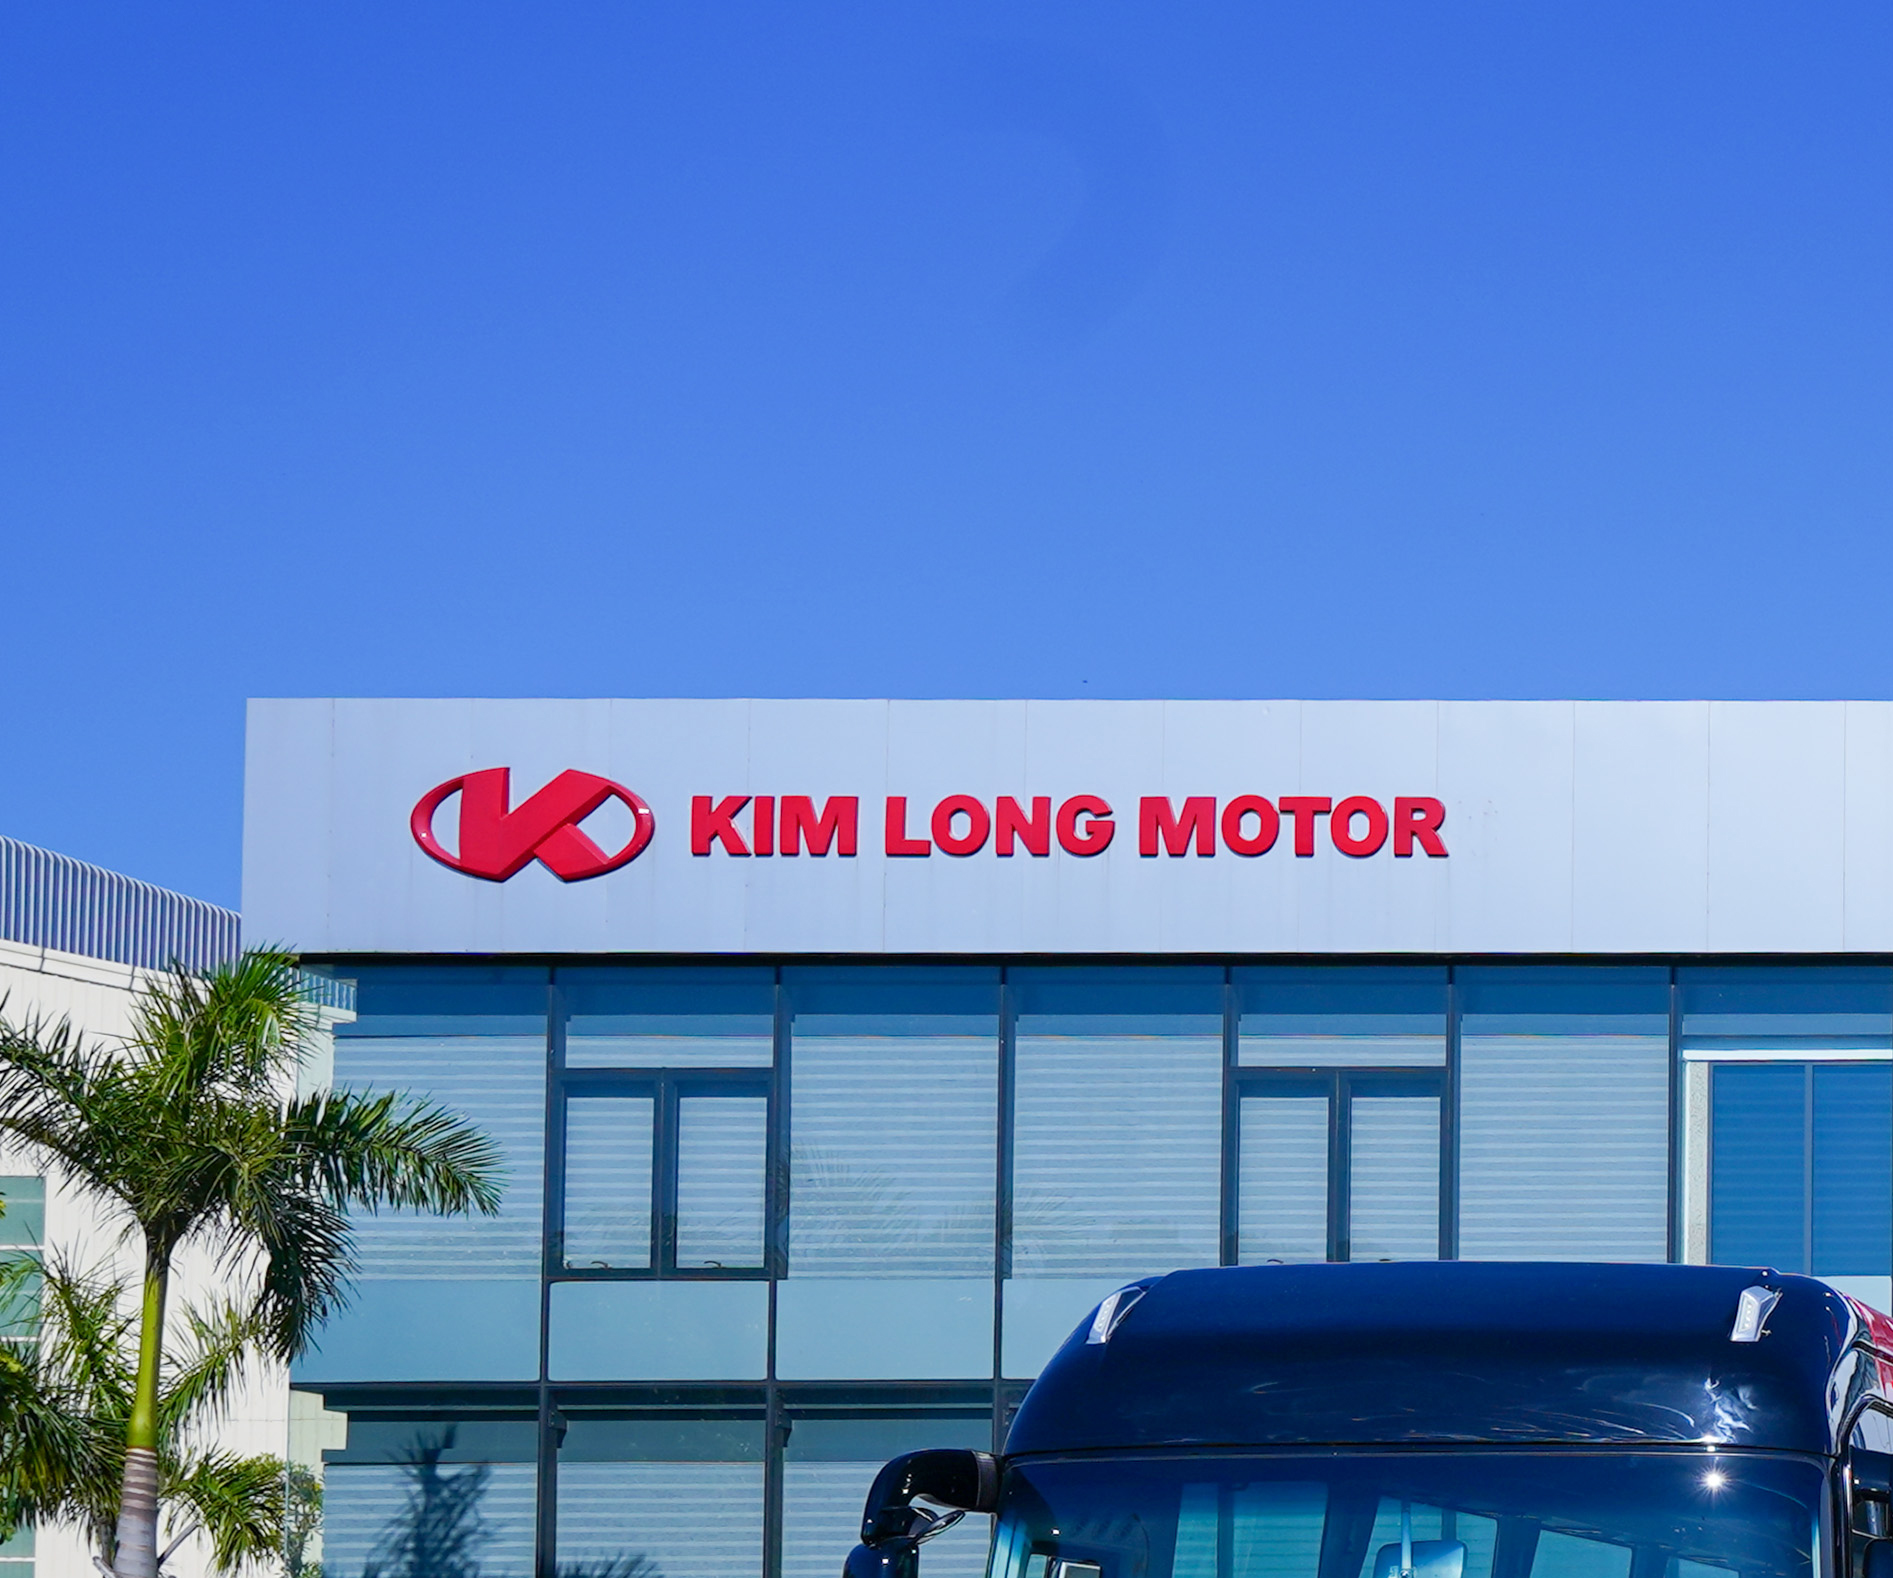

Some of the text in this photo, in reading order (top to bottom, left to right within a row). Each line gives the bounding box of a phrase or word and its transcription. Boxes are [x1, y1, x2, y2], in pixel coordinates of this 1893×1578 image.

[691, 794, 1450, 860] KIM LONG MOTOR
